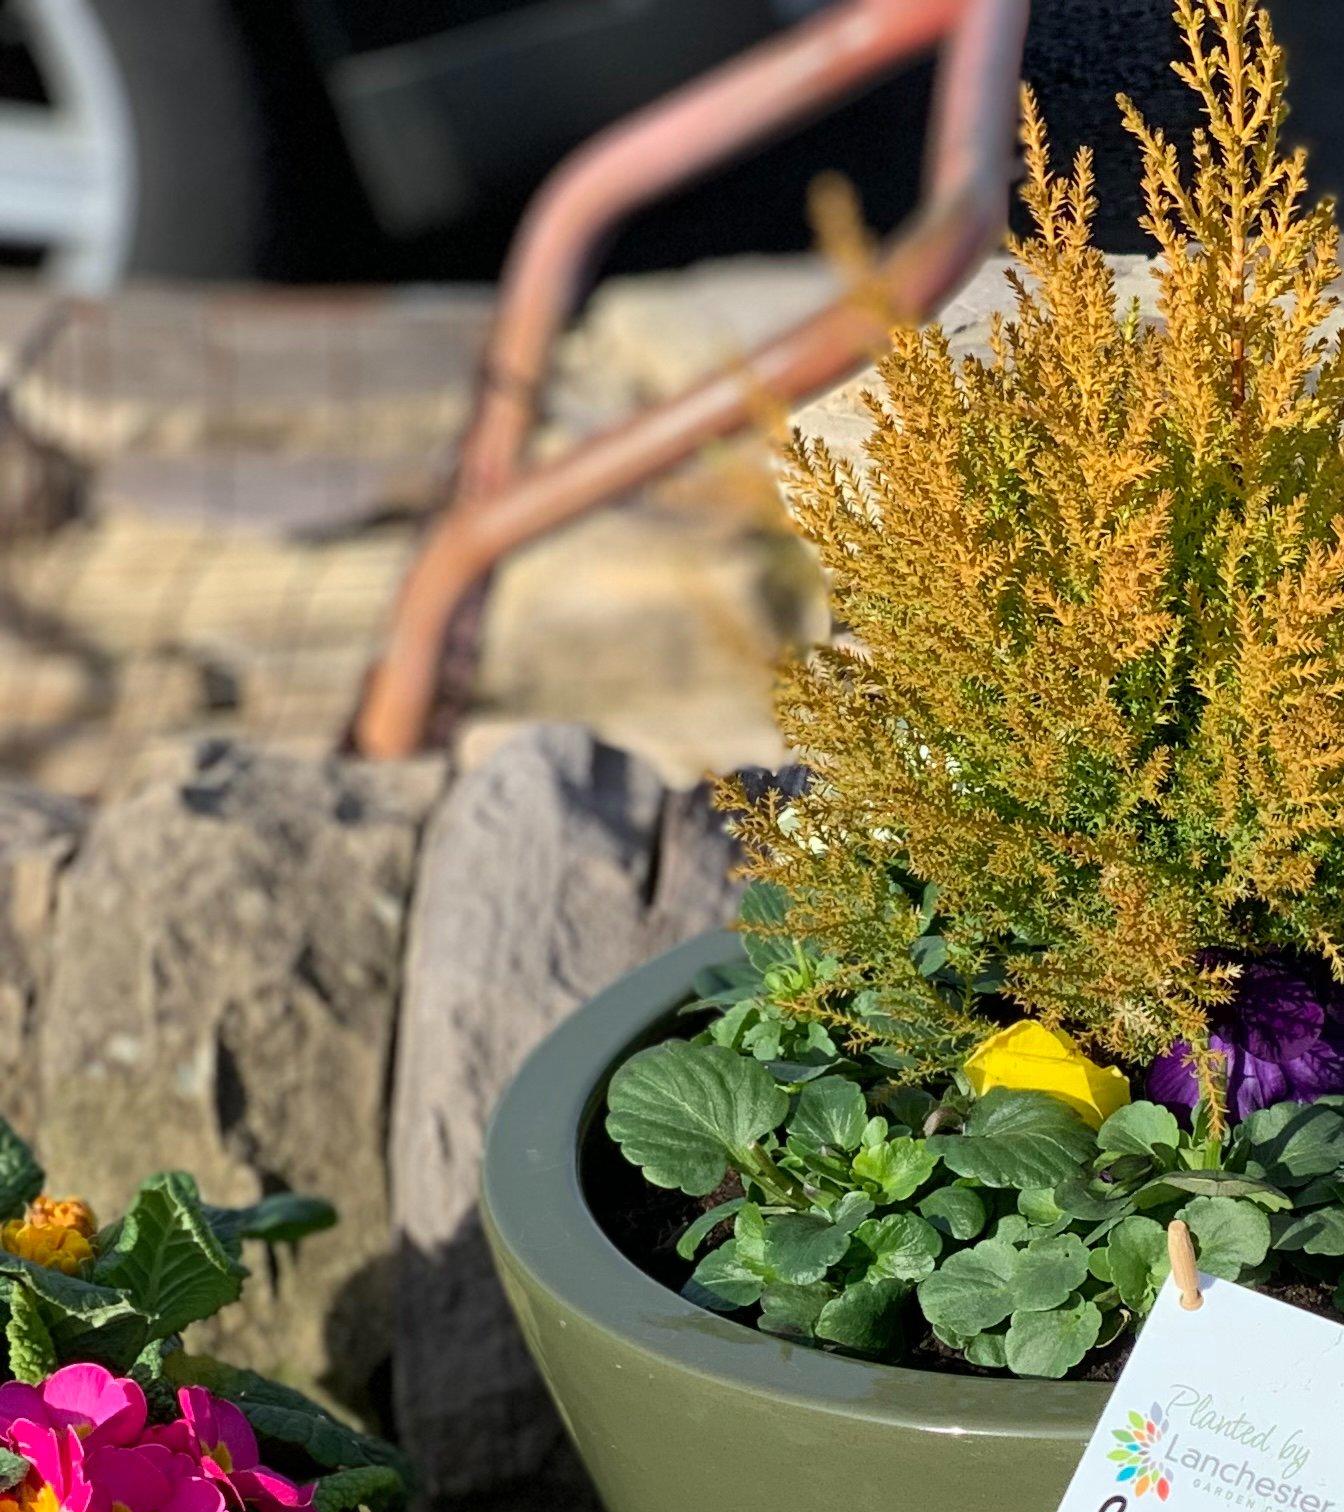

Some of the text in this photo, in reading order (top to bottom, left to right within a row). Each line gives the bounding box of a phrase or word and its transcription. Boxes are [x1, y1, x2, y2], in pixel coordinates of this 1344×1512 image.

[1165, 1384, 1310, 1479] Planted by
[1193, 1478, 1255, 1509] GARDEN
